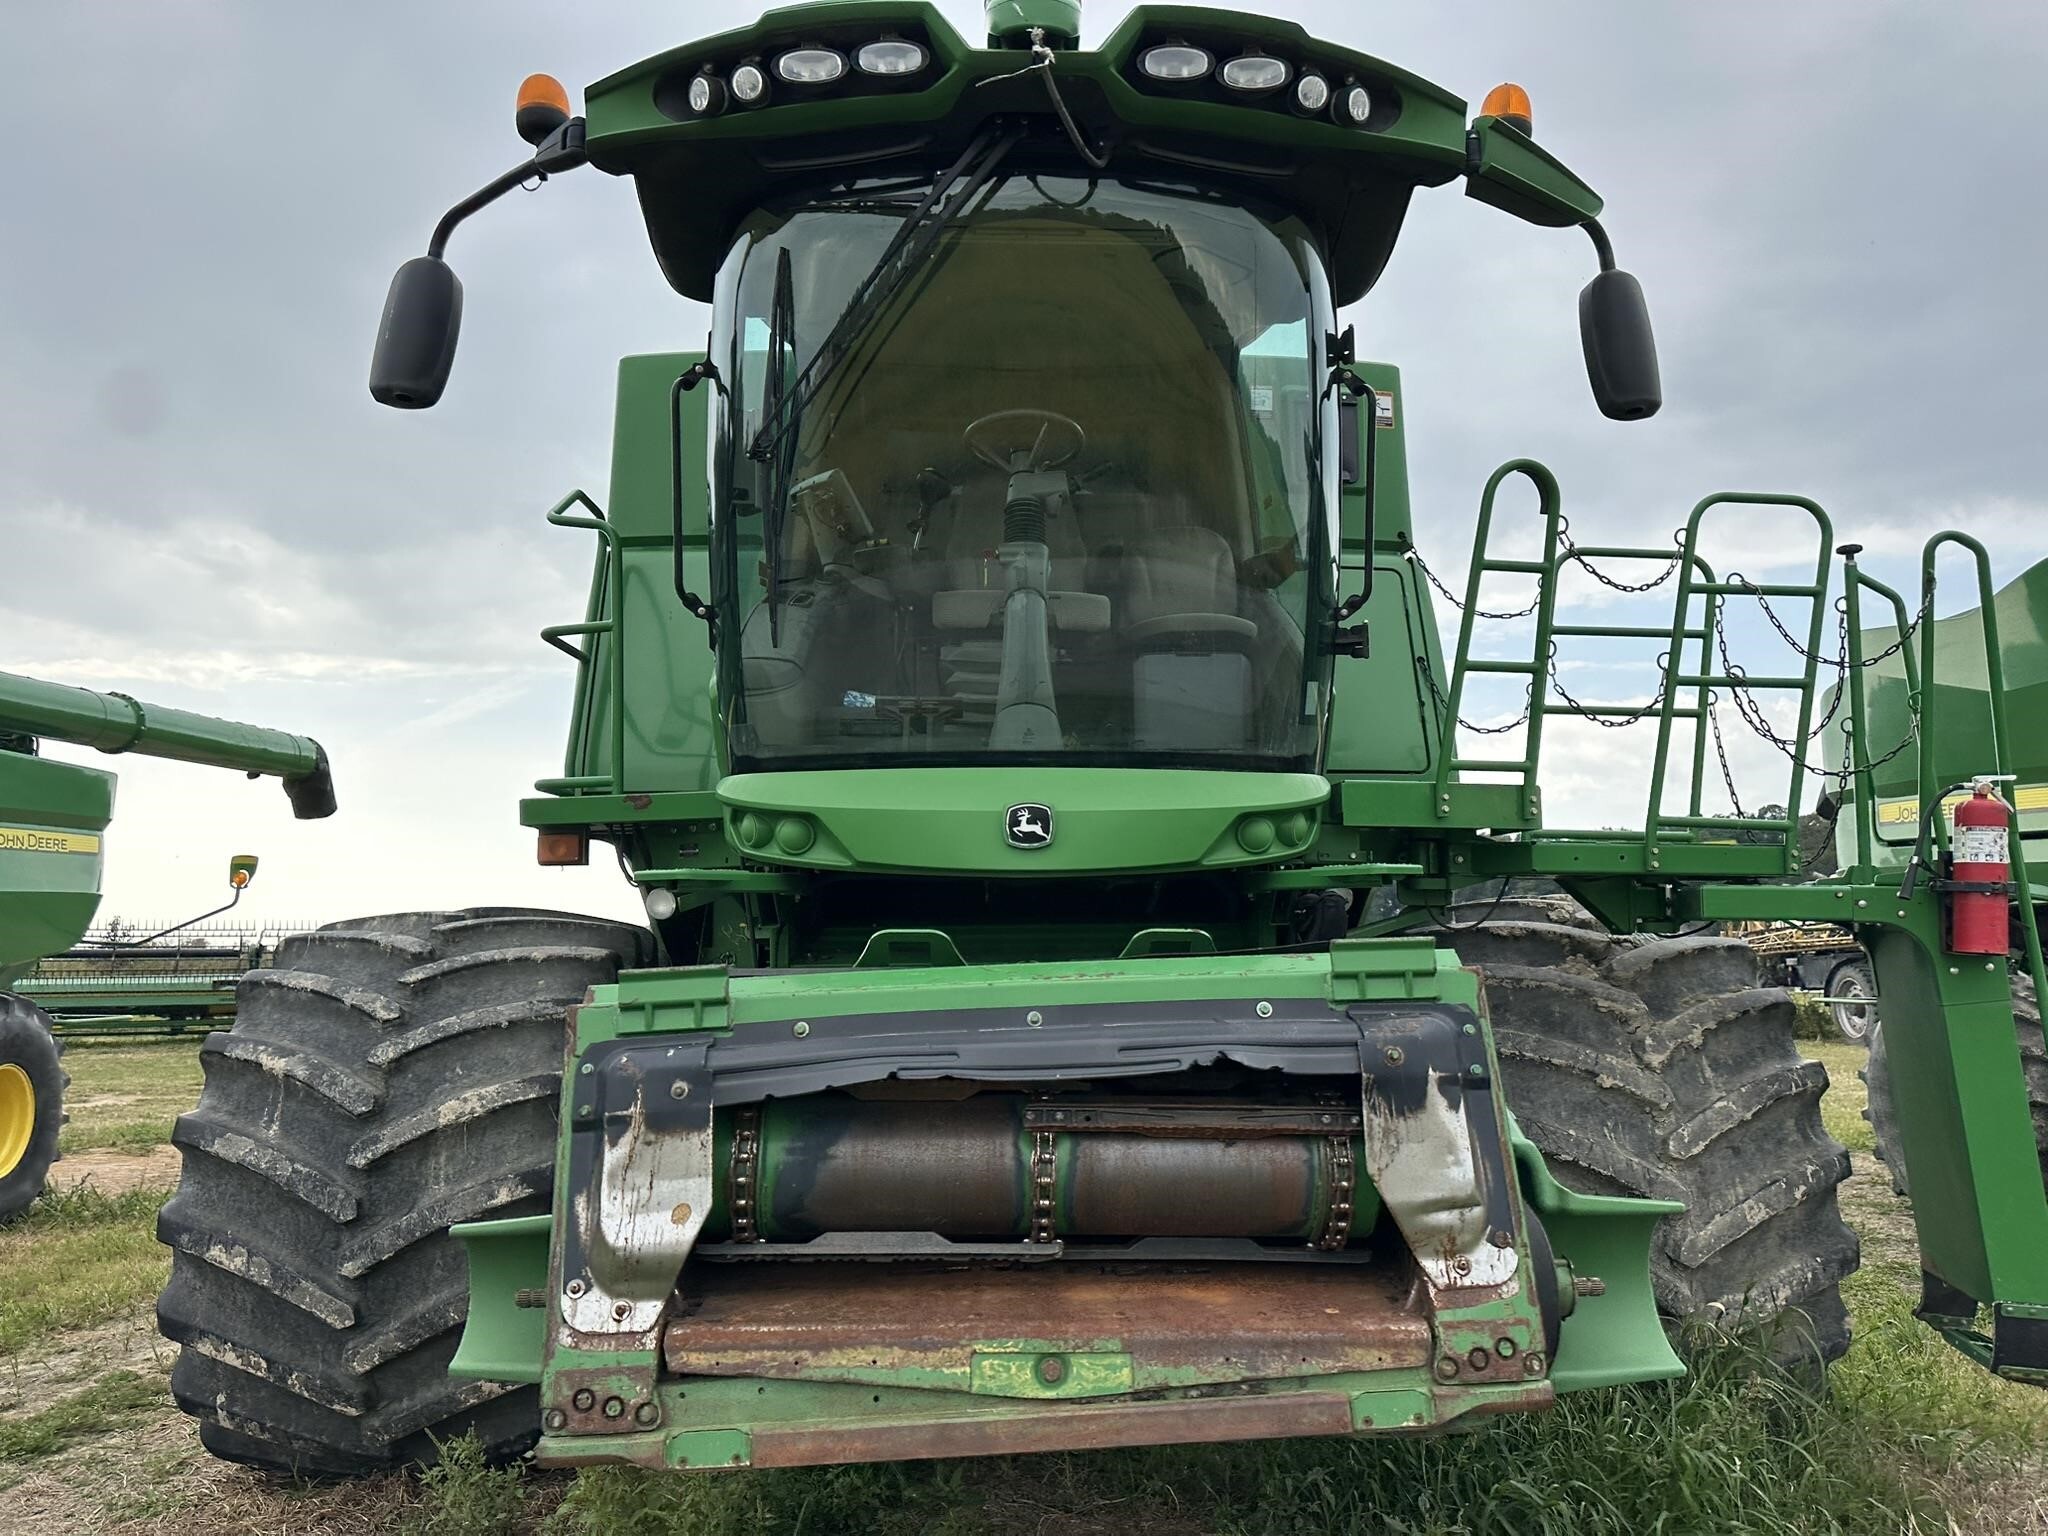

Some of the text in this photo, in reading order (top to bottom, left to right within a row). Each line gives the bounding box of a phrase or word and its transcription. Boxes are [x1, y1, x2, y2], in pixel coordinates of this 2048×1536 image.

[1895, 806, 1919, 821] JOH
[0, 833, 68, 850] OHN DEERE
